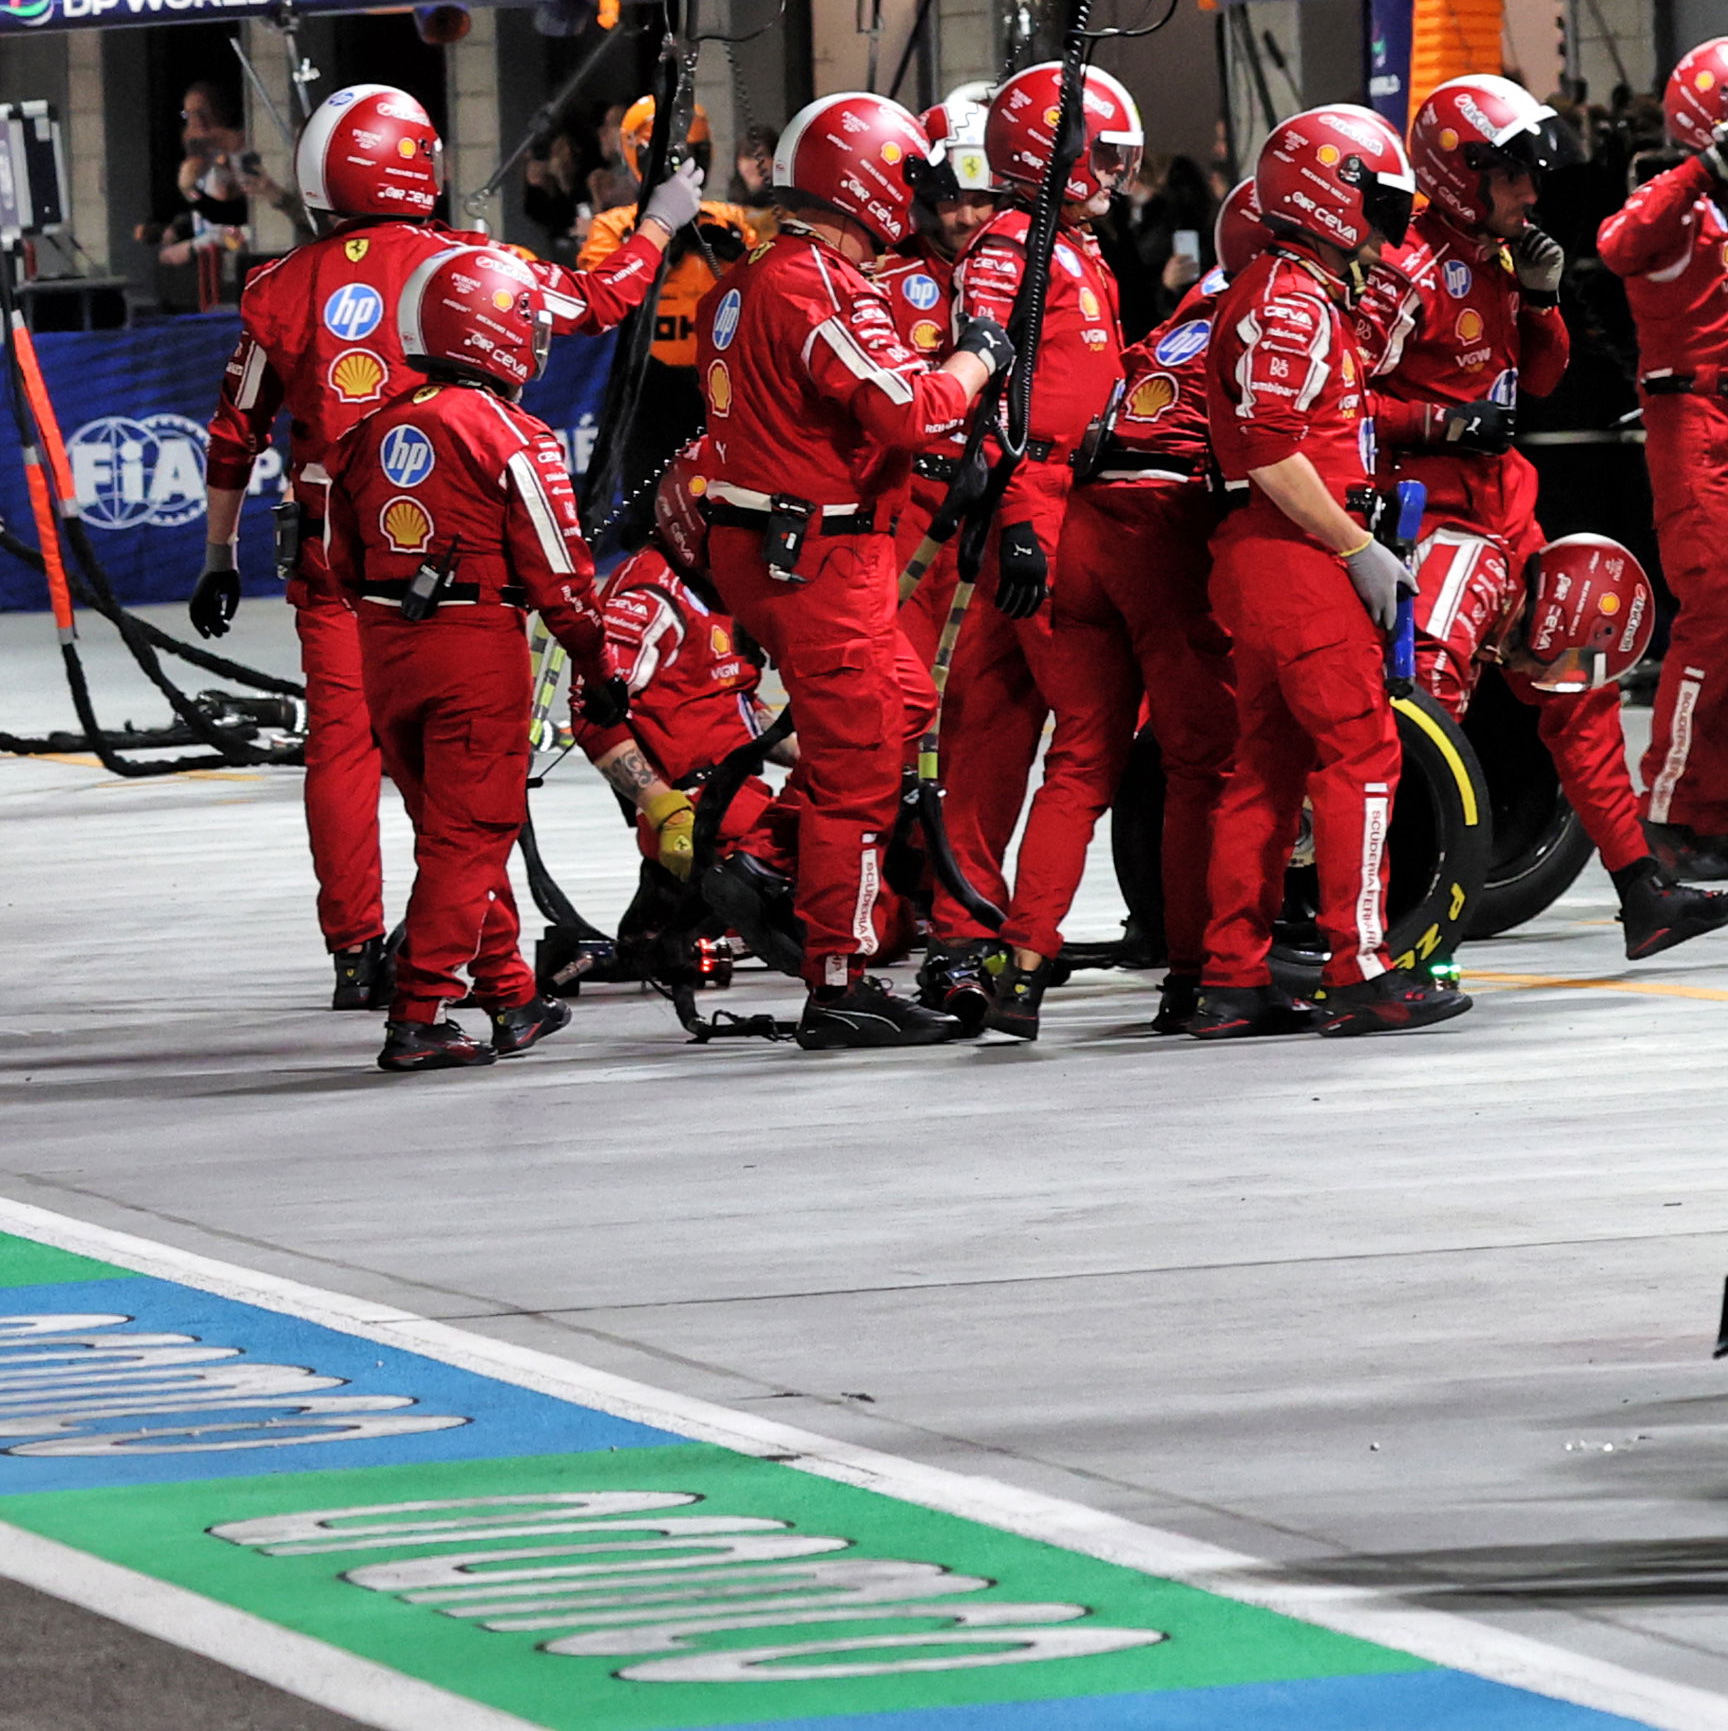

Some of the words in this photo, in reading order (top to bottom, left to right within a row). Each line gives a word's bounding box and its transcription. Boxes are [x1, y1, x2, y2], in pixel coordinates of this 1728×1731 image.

[1314, 206, 1358, 242] CEVA
[906, 277, 936, 309] hp
[328, 287, 381, 339] hp
[1159, 322, 1208, 365] hp
[1456, 348, 1492, 368] VGW
[491, 348, 528, 379] CEVA
[382, 427, 433, 487] hp
[606, 598, 649, 616] CEVA
[204, 1490, 1170, 1682] aramco
